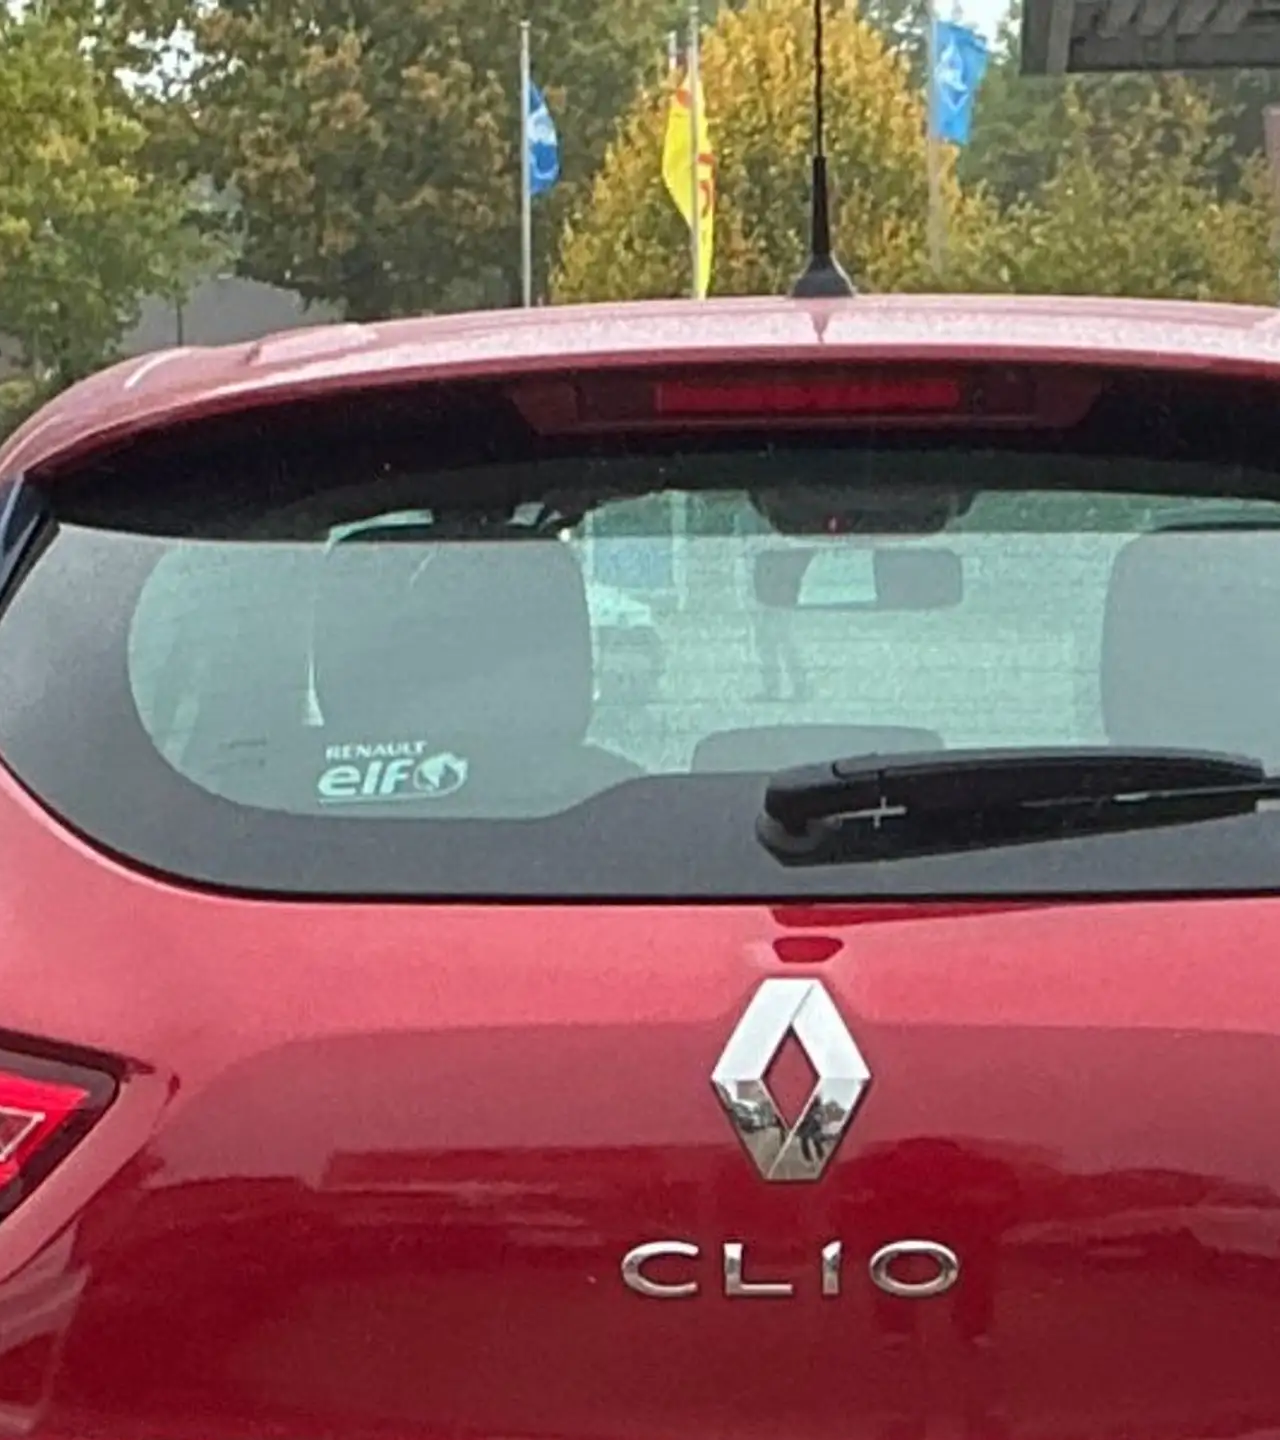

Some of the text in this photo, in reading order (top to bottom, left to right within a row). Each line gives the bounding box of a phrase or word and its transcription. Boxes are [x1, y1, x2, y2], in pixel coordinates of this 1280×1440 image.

[325, 740, 427, 760] RENAULT
[317, 758, 414, 796] elf
[621, 1239, 959, 1298] CLIO
